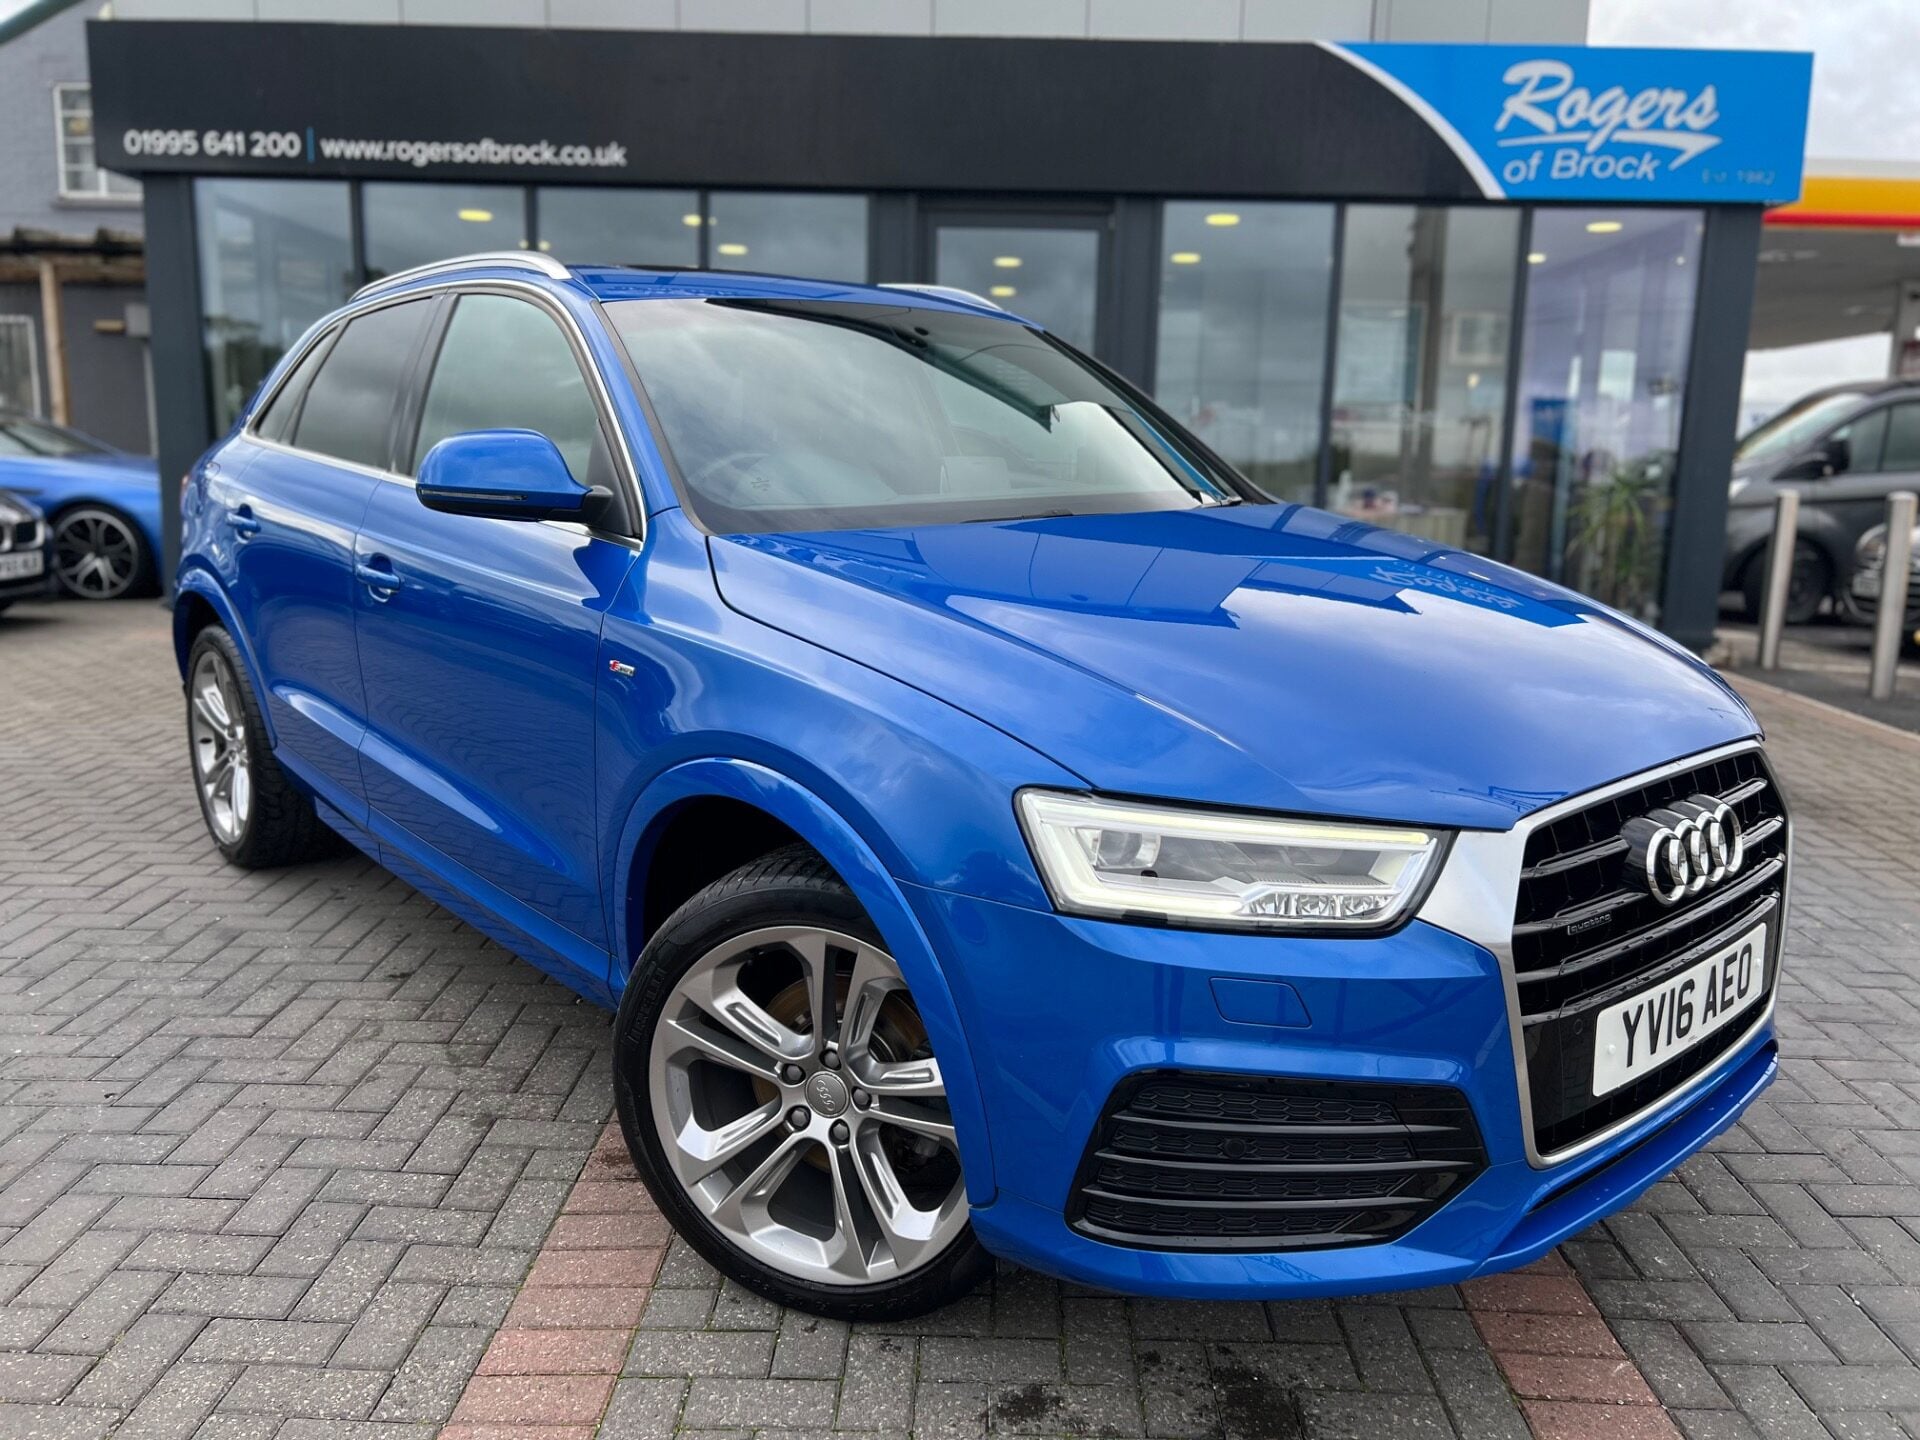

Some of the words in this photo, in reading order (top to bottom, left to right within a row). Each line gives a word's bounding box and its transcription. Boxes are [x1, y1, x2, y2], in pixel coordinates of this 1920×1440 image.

[1494, 59, 1720, 153] Rogers
[123, 129, 199, 156] 01995
[203, 130, 246, 156] 641
[250, 131, 301, 157] 200
[320, 137, 627, 168] www.rogersofbrock.co.uk
[1503, 150, 1543, 184] of
[1550, 149, 1660, 182] Brock
[1622, 978, 1695, 1068] YV16
[1702, 942, 1752, 1025] AEO
